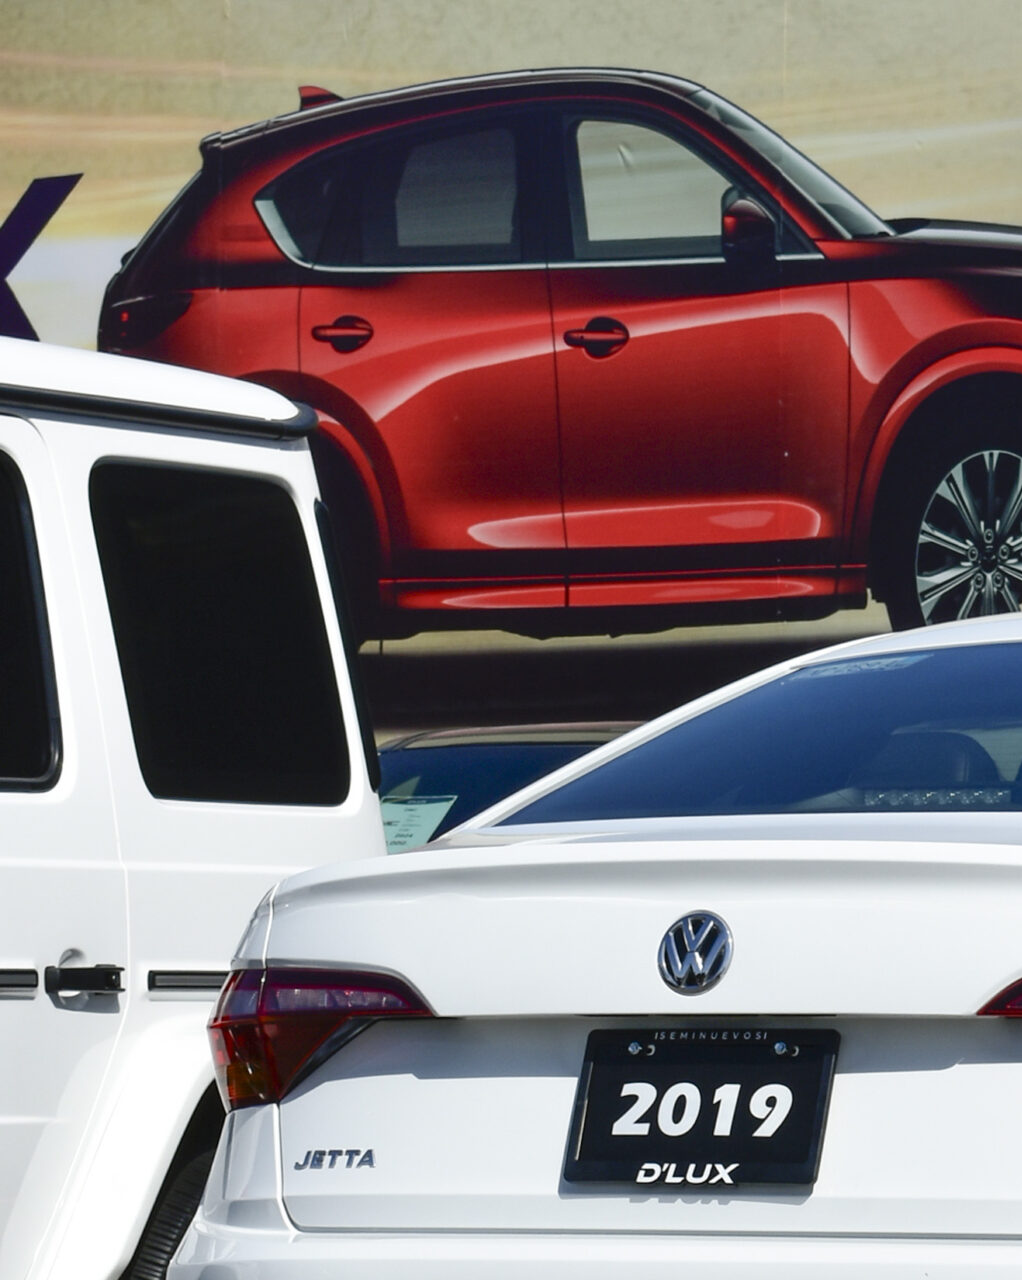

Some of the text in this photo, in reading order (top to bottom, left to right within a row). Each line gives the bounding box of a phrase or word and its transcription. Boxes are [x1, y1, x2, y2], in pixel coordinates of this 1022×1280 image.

[611, 1082, 793, 1137] 2019
[294, 1149, 376, 1170] JETTA
[636, 1163, 740, 1184] D'LUX
